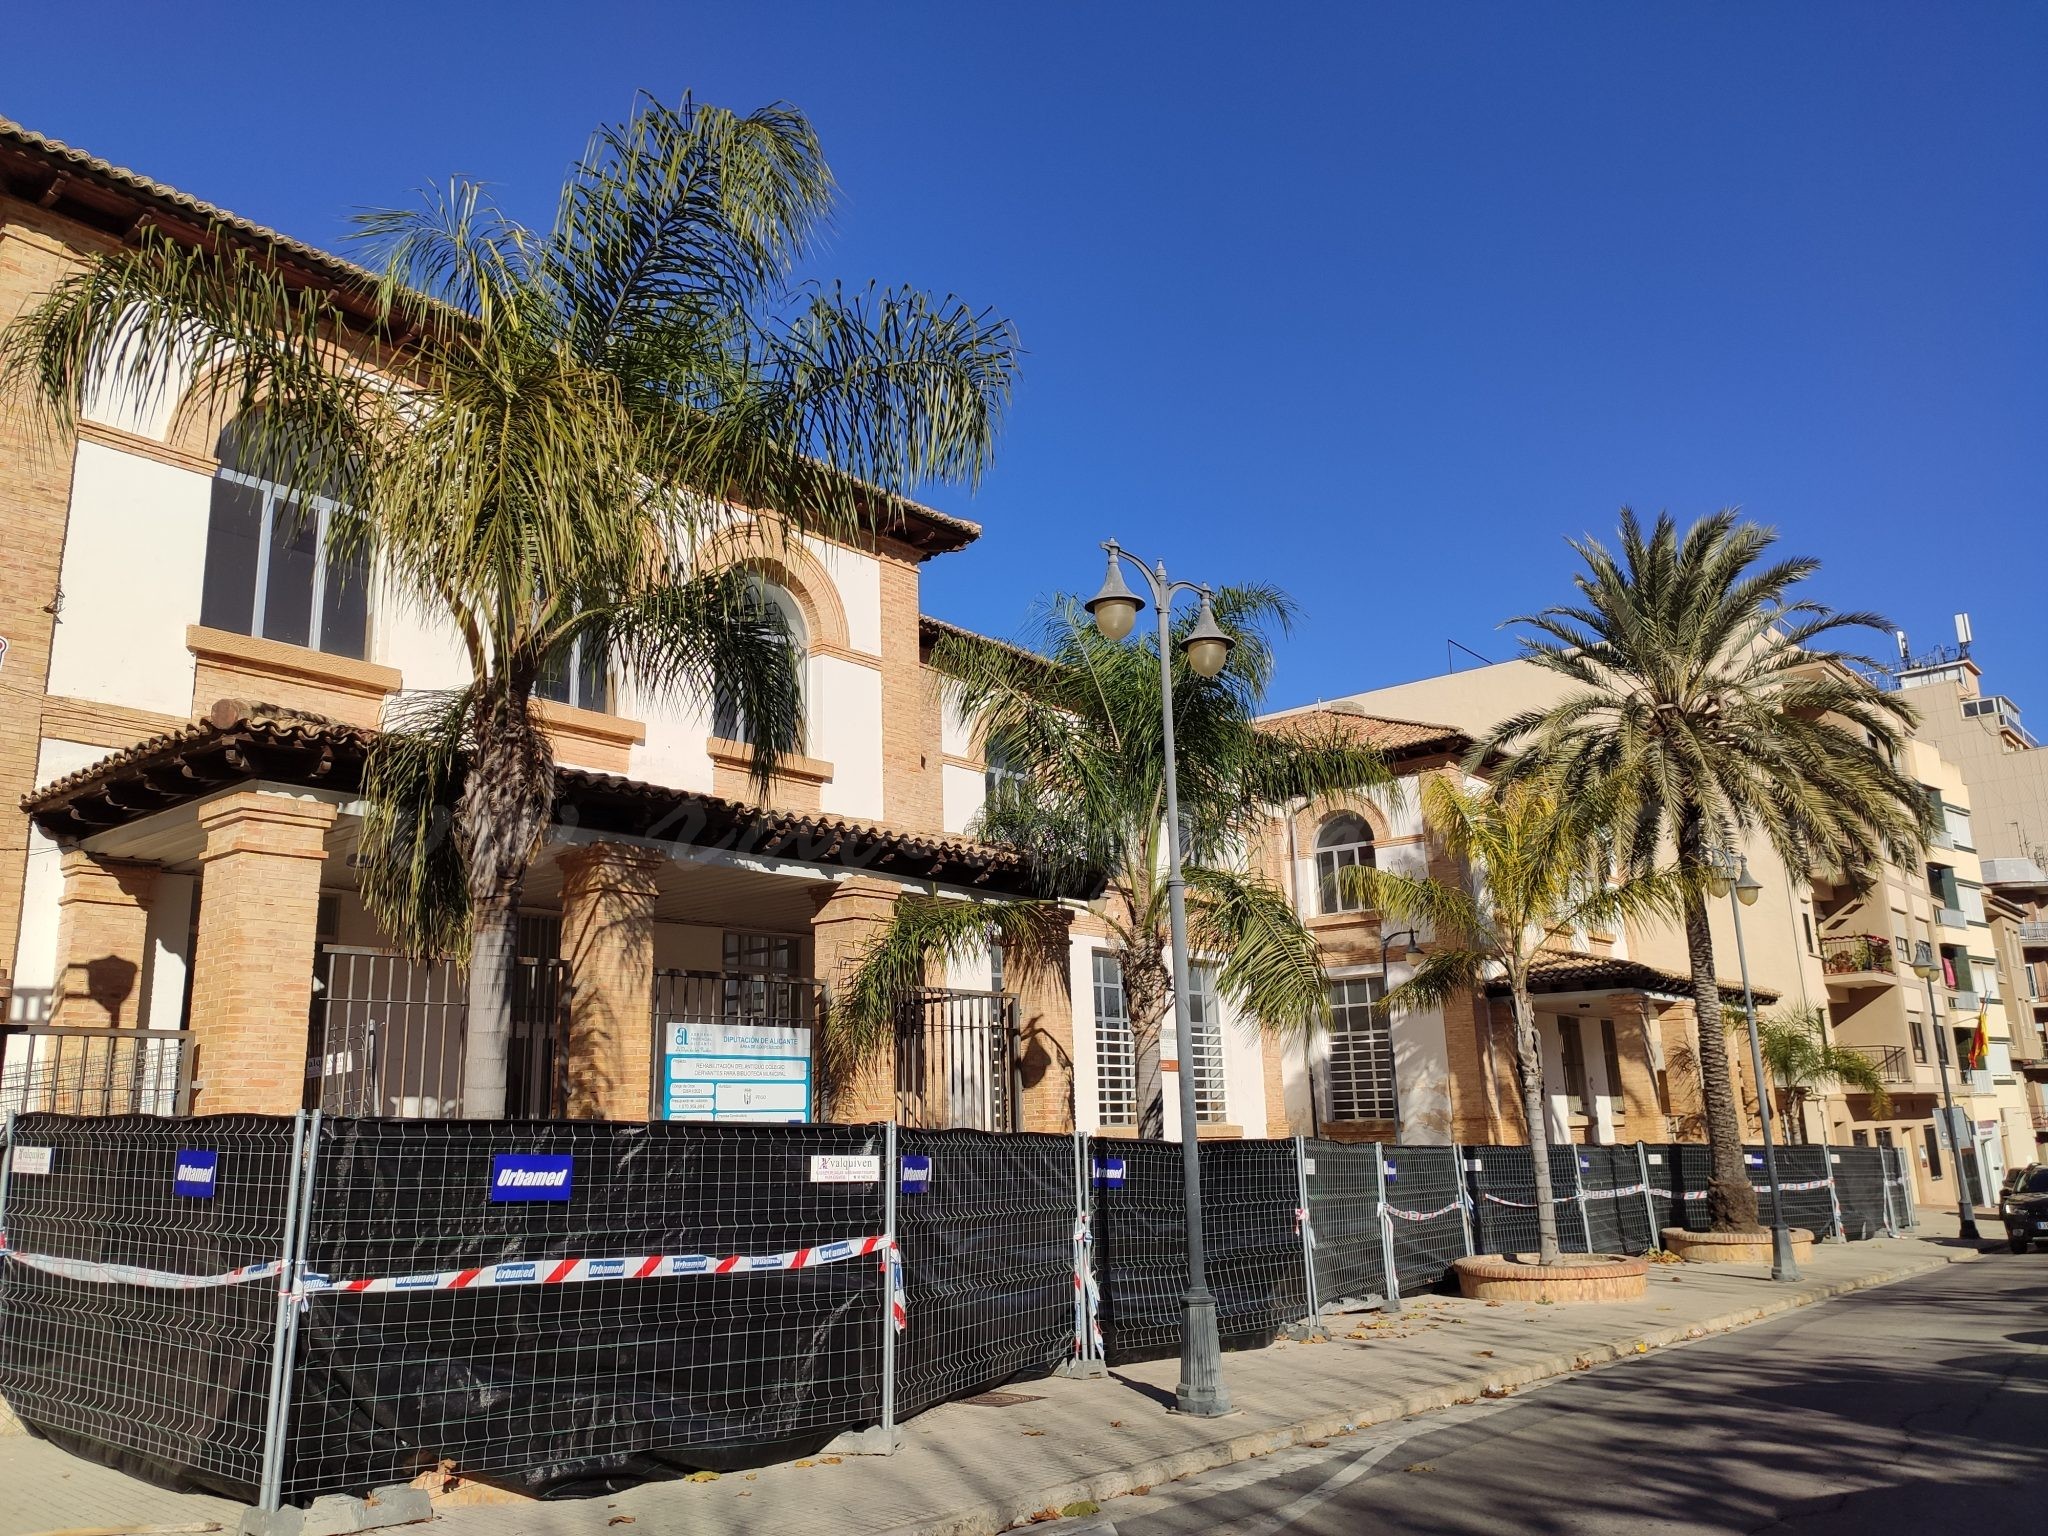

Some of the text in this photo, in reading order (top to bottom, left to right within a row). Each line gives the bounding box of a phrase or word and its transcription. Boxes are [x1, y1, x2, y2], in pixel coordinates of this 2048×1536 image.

[723, 1035, 798, 1046] DIPUTACIÓN DE ALICANTE
[829, 1157, 873, 1170] valquiven
[177, 1164, 214, 1183] Urbamed
[497, 1168, 568, 1187] Urbamed
[496, 1267, 535, 1280] Urbamed
[589, 1262, 625, 1275] Urbamed
